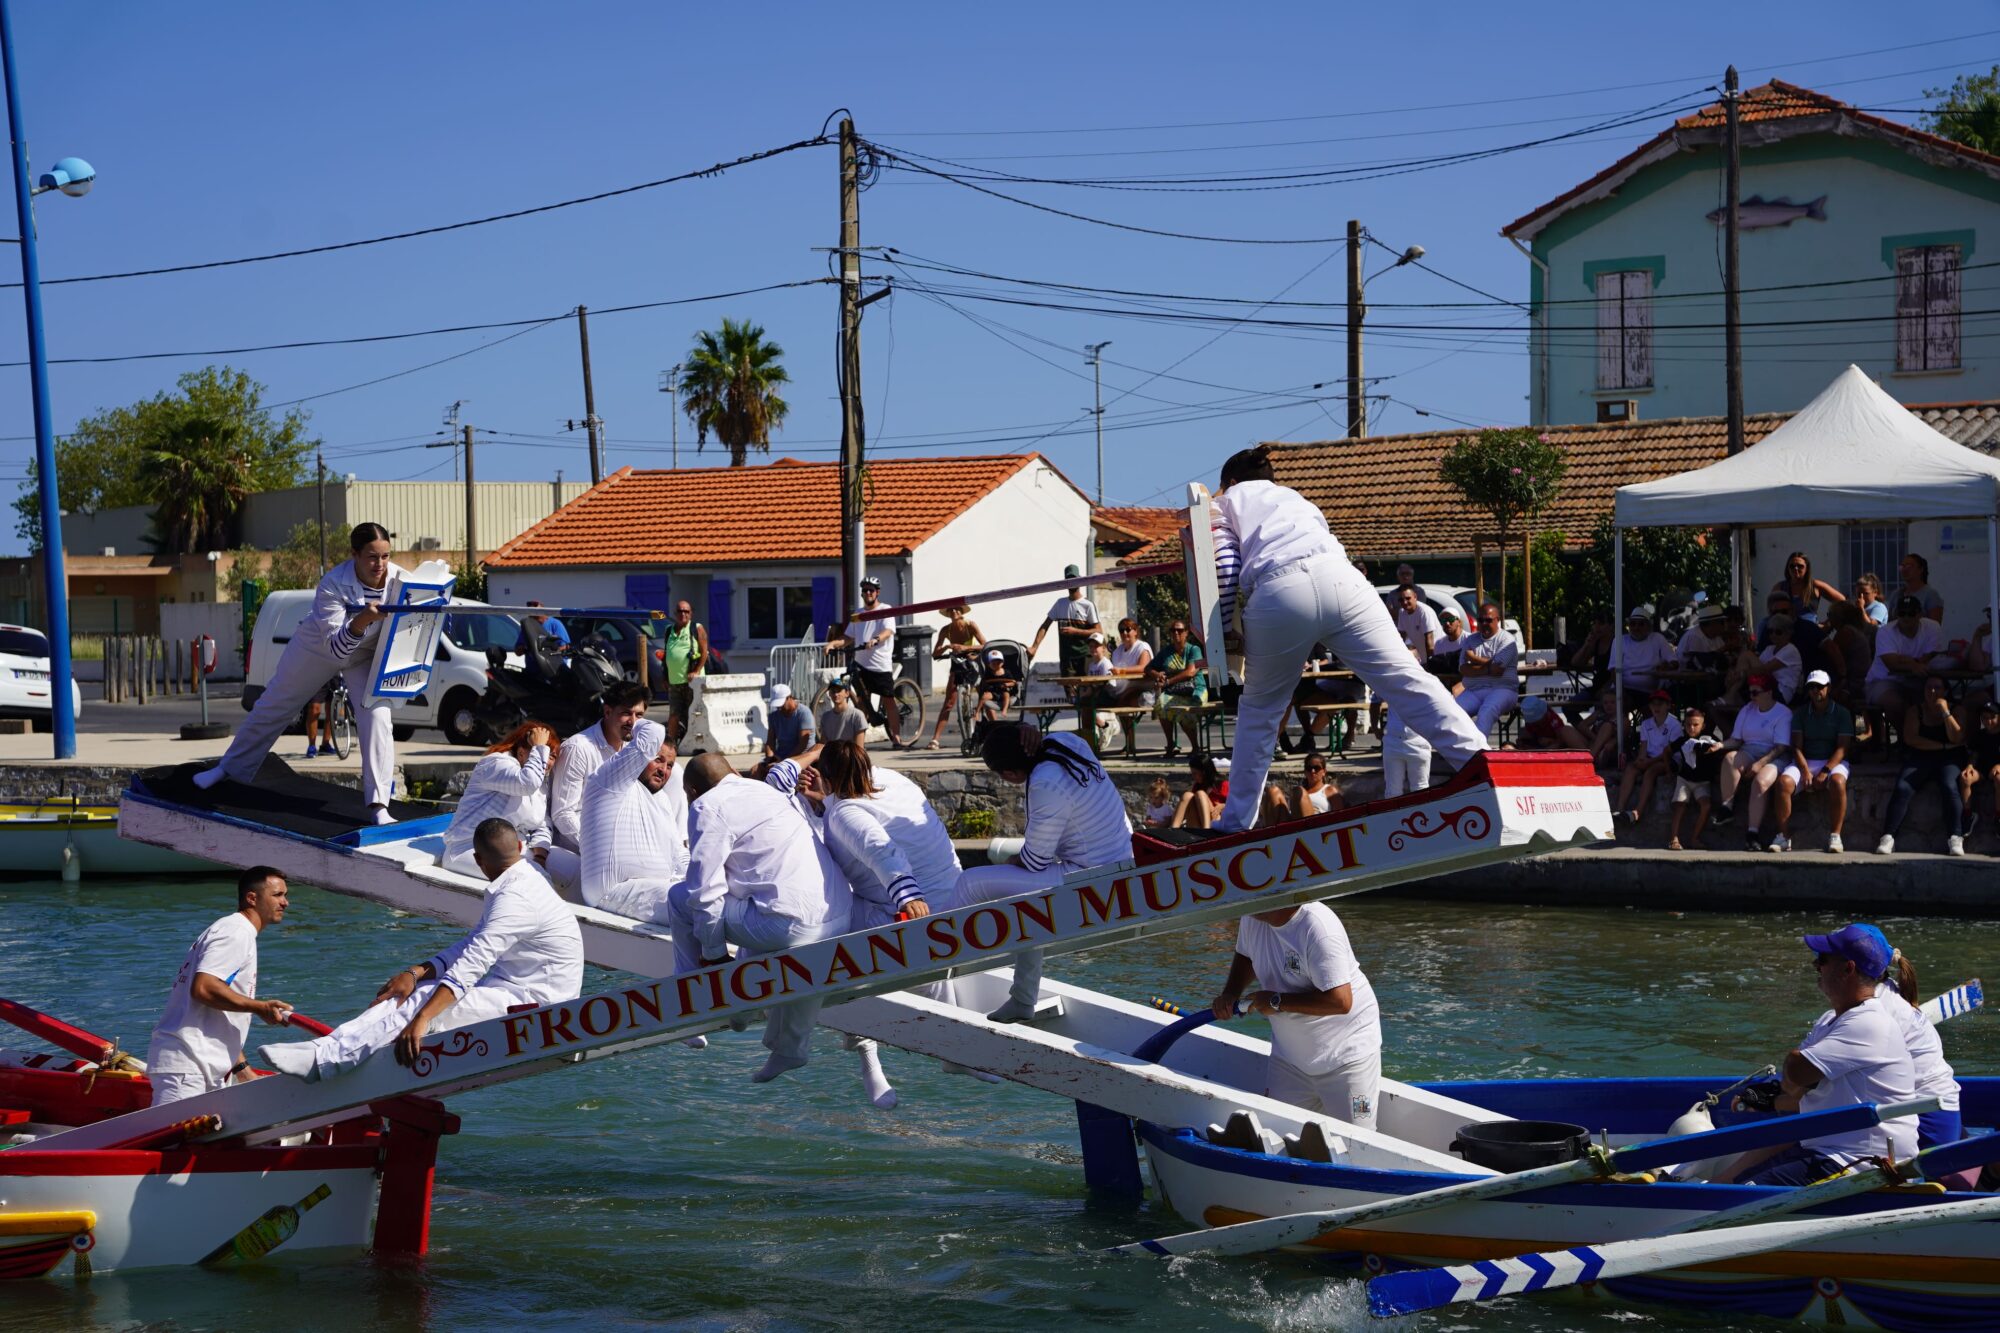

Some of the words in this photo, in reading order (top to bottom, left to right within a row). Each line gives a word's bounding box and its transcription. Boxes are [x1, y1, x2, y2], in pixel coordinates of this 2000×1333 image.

[1515, 795, 1536, 816] SJF
[1540, 801, 1584, 815] FRONTIGNAN
[501, 927, 910, 1057] FRONTIGNAN
[927, 894, 1057, 962] SON
[1073, 822, 1369, 929] MUSCAT
